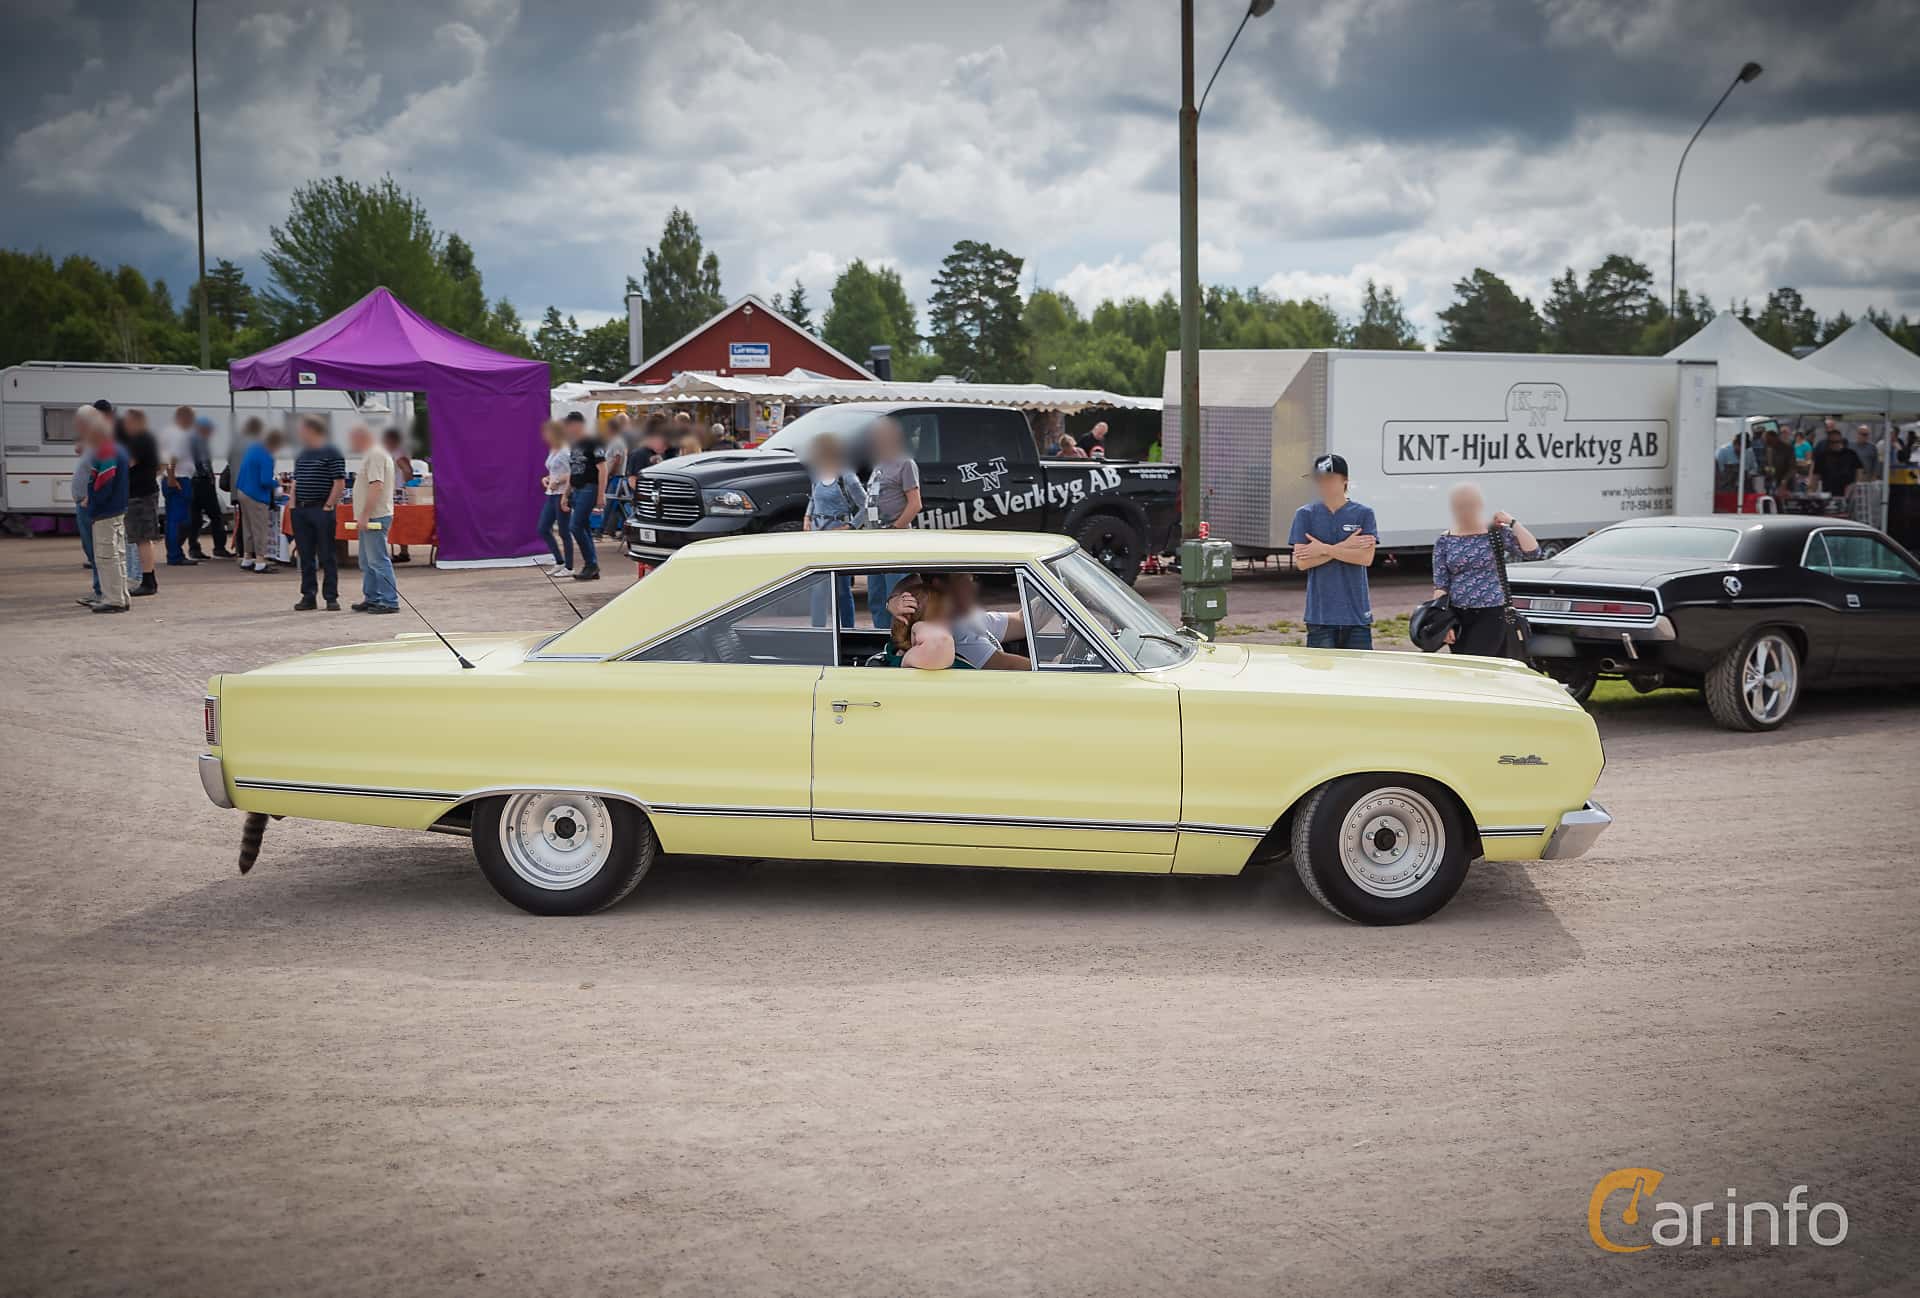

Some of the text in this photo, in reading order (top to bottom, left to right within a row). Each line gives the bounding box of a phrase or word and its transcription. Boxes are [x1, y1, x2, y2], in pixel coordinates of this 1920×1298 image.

[1398, 432, 1659, 468] KNT-Hjul & Verktyg AB
[957, 456, 1009, 492] KNT
[973, 497, 997, 523] &
[992, 479, 1085, 509] Verktyg
[1090, 467, 1122, 492] AB
